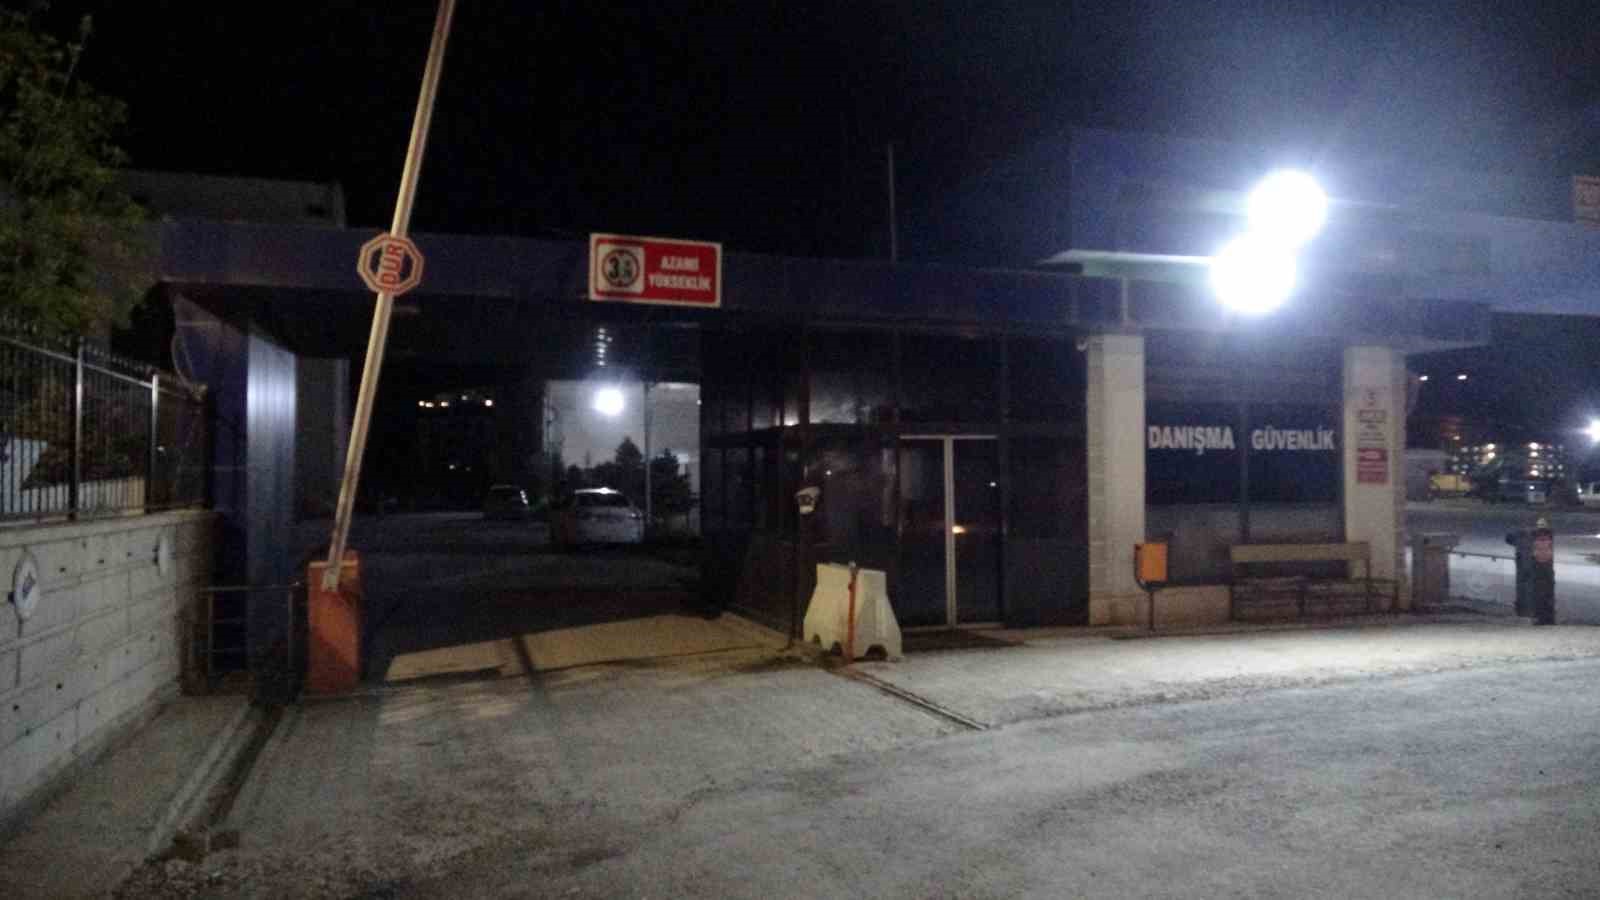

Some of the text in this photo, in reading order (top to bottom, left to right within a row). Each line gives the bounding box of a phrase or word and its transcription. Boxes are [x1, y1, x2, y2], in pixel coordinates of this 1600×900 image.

[377, 242, 404, 286] DUR
[1148, 426, 1235, 455] DANIŞMA
[1252, 425, 1335, 450] GÜVENLİK
